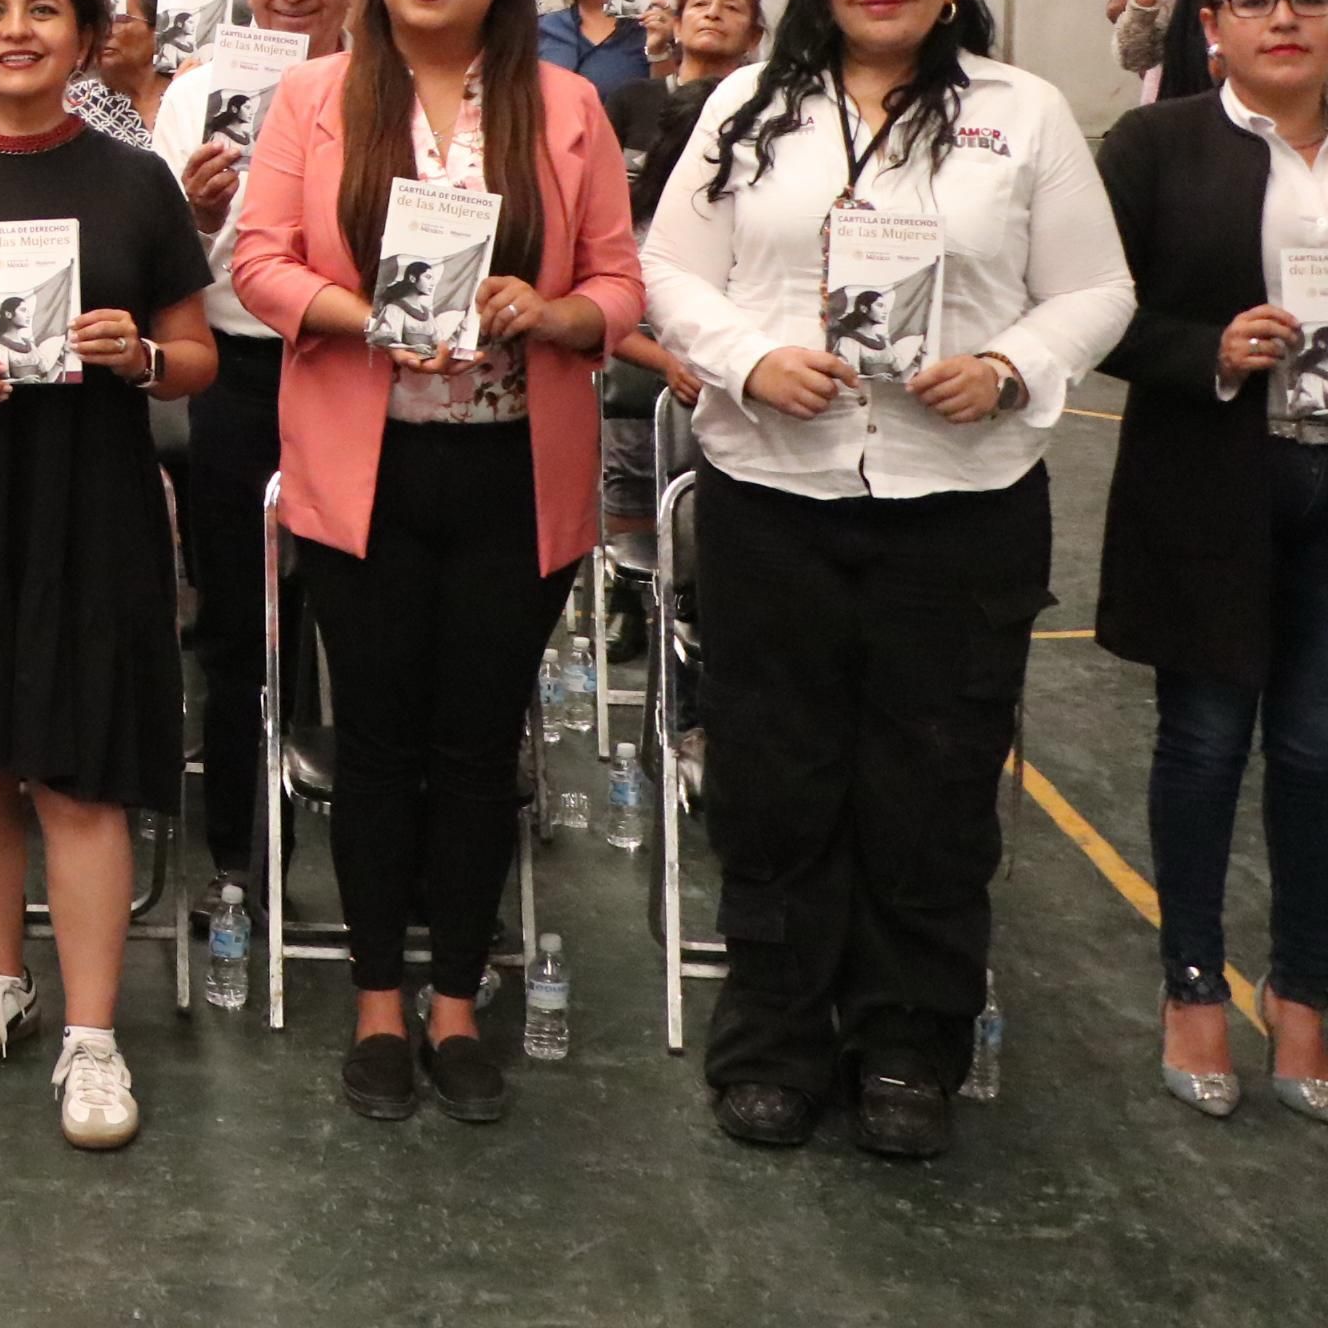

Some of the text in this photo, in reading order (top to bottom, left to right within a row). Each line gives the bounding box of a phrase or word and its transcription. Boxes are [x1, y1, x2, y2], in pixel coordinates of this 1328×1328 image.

[221, 30, 298, 46] CARTILLA DE DERECHOS
[220, 38, 297, 56] de las Mujeres
[954, 136, 1012, 158] UEBLA
[399, 184, 493, 207] CARTILLA DE DERECHOS
[397, 195, 491, 220] de las Mujeres
[30, 225, 70, 233] DERECHOS
[838, 215, 878, 224] CARTILLA
[894, 218, 938, 227] DERECHOS
[0, 236, 16, 247] las
[20, 235, 71, 248] Mujeres
[838, 226, 937, 241] de las Mujeres
